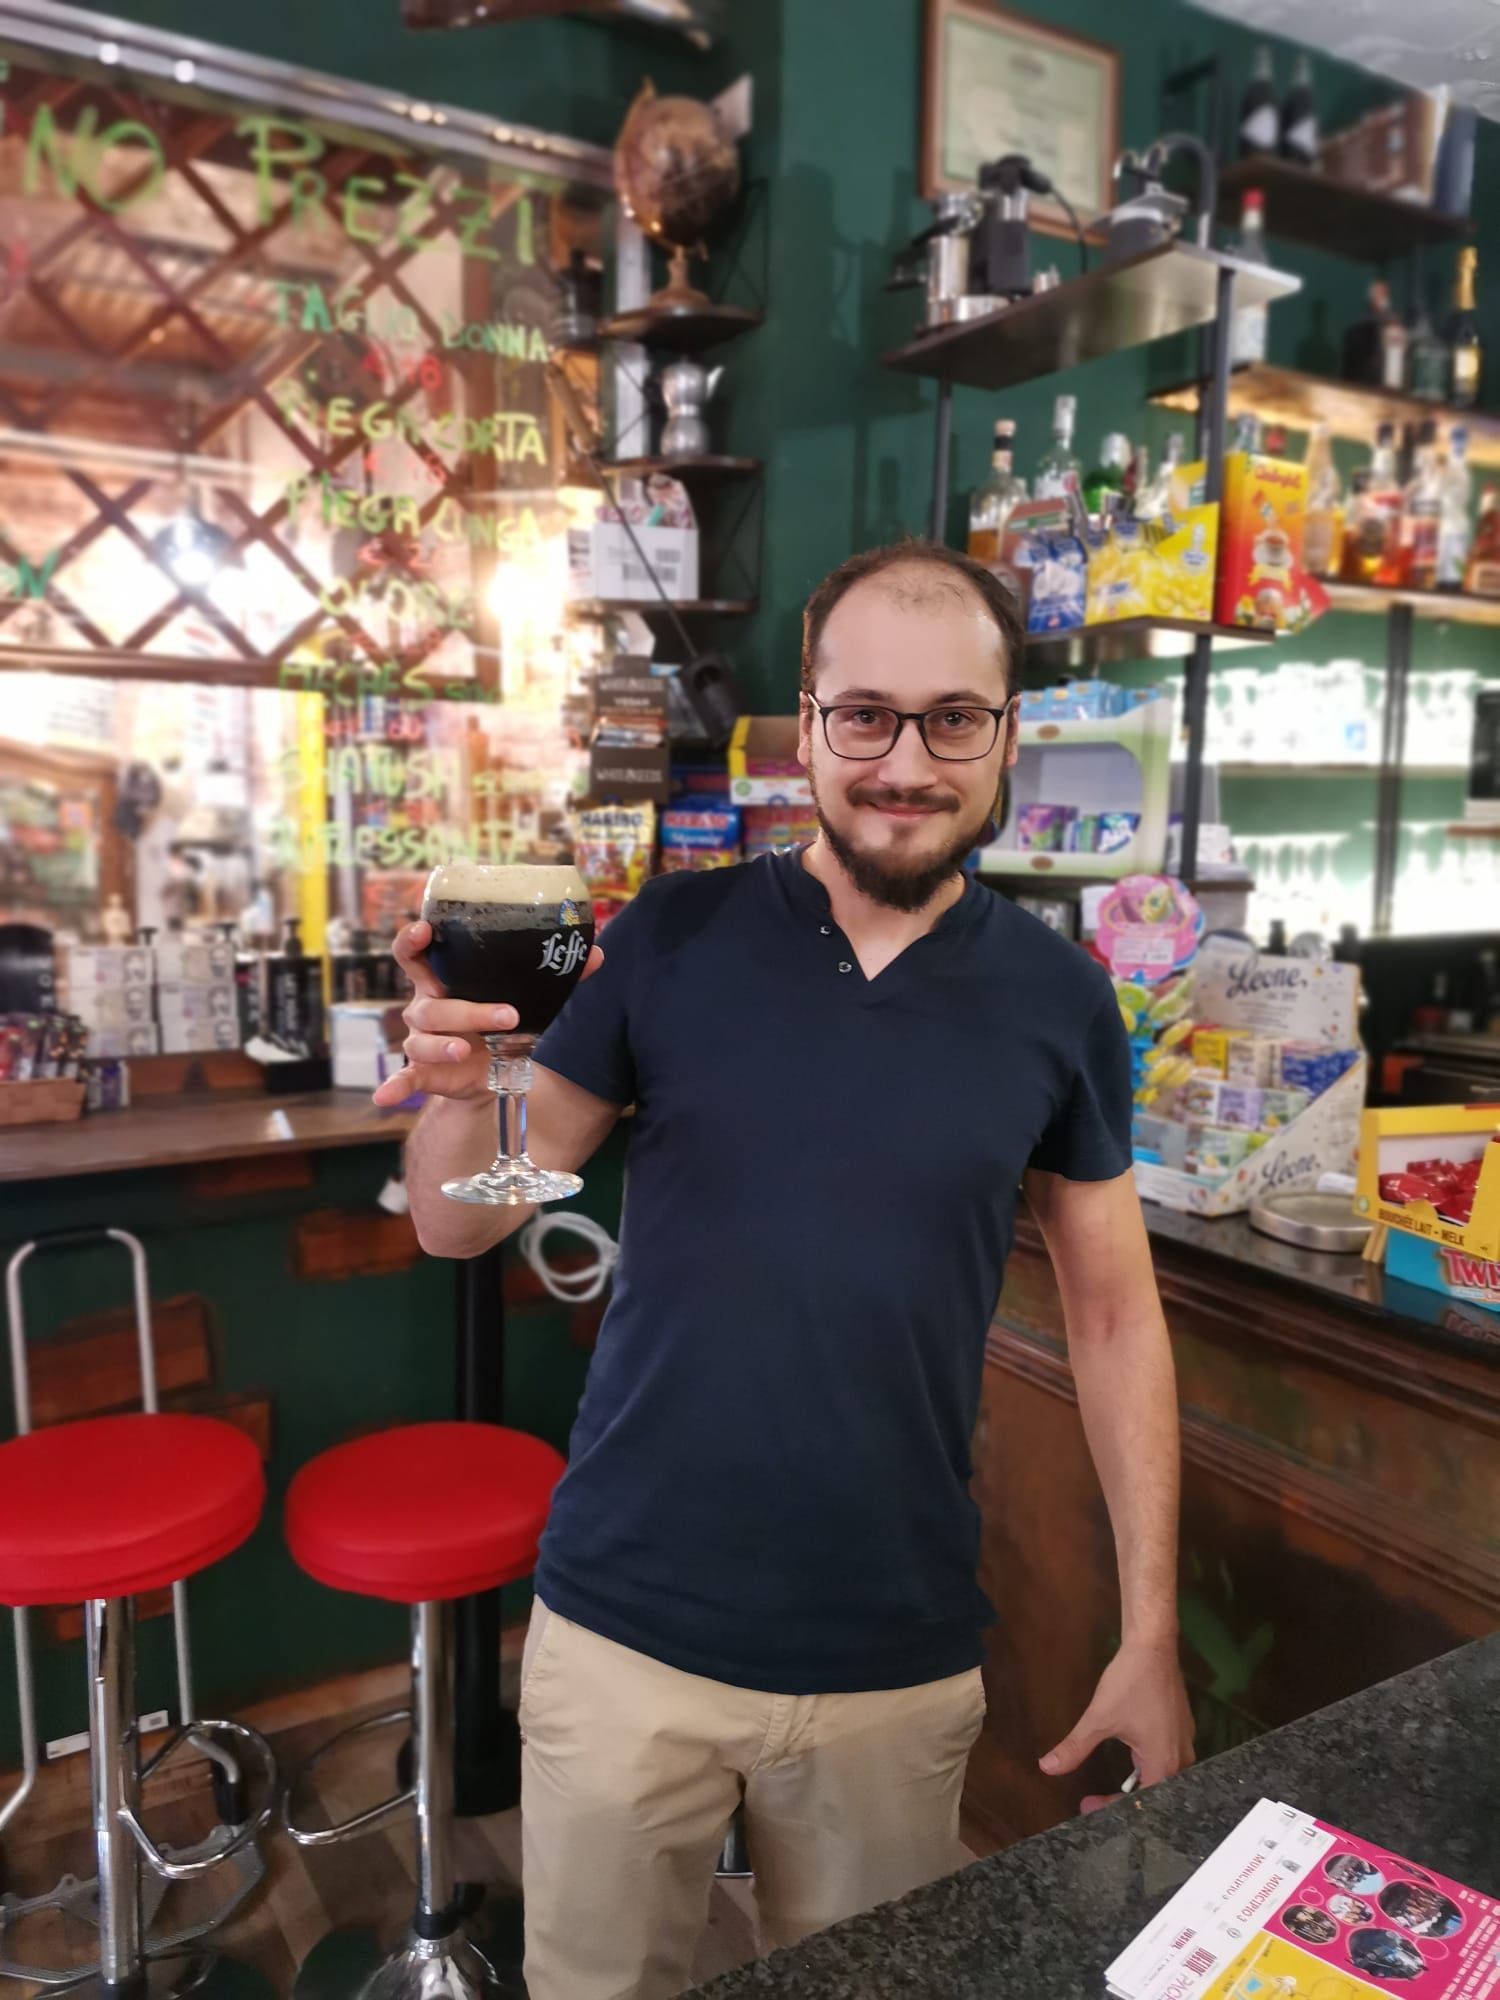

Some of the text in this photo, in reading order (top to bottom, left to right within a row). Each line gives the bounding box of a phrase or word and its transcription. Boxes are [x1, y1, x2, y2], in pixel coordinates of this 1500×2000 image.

[235, 115, 536, 266] PREZZI
[441, 308, 549, 362] DONNA
[431, 411, 547, 466] CORTA
[286, 472, 421, 537] PIEGA
[536, 930, 588, 976] Leffe
[1414, 1219, 1432, 1237] LAIT
[1441, 1228, 1465, 1247] MELK
[1439, 1246, 1500, 1291] TWI
[1243, 1874, 1283, 1917] MUNICIPIO
